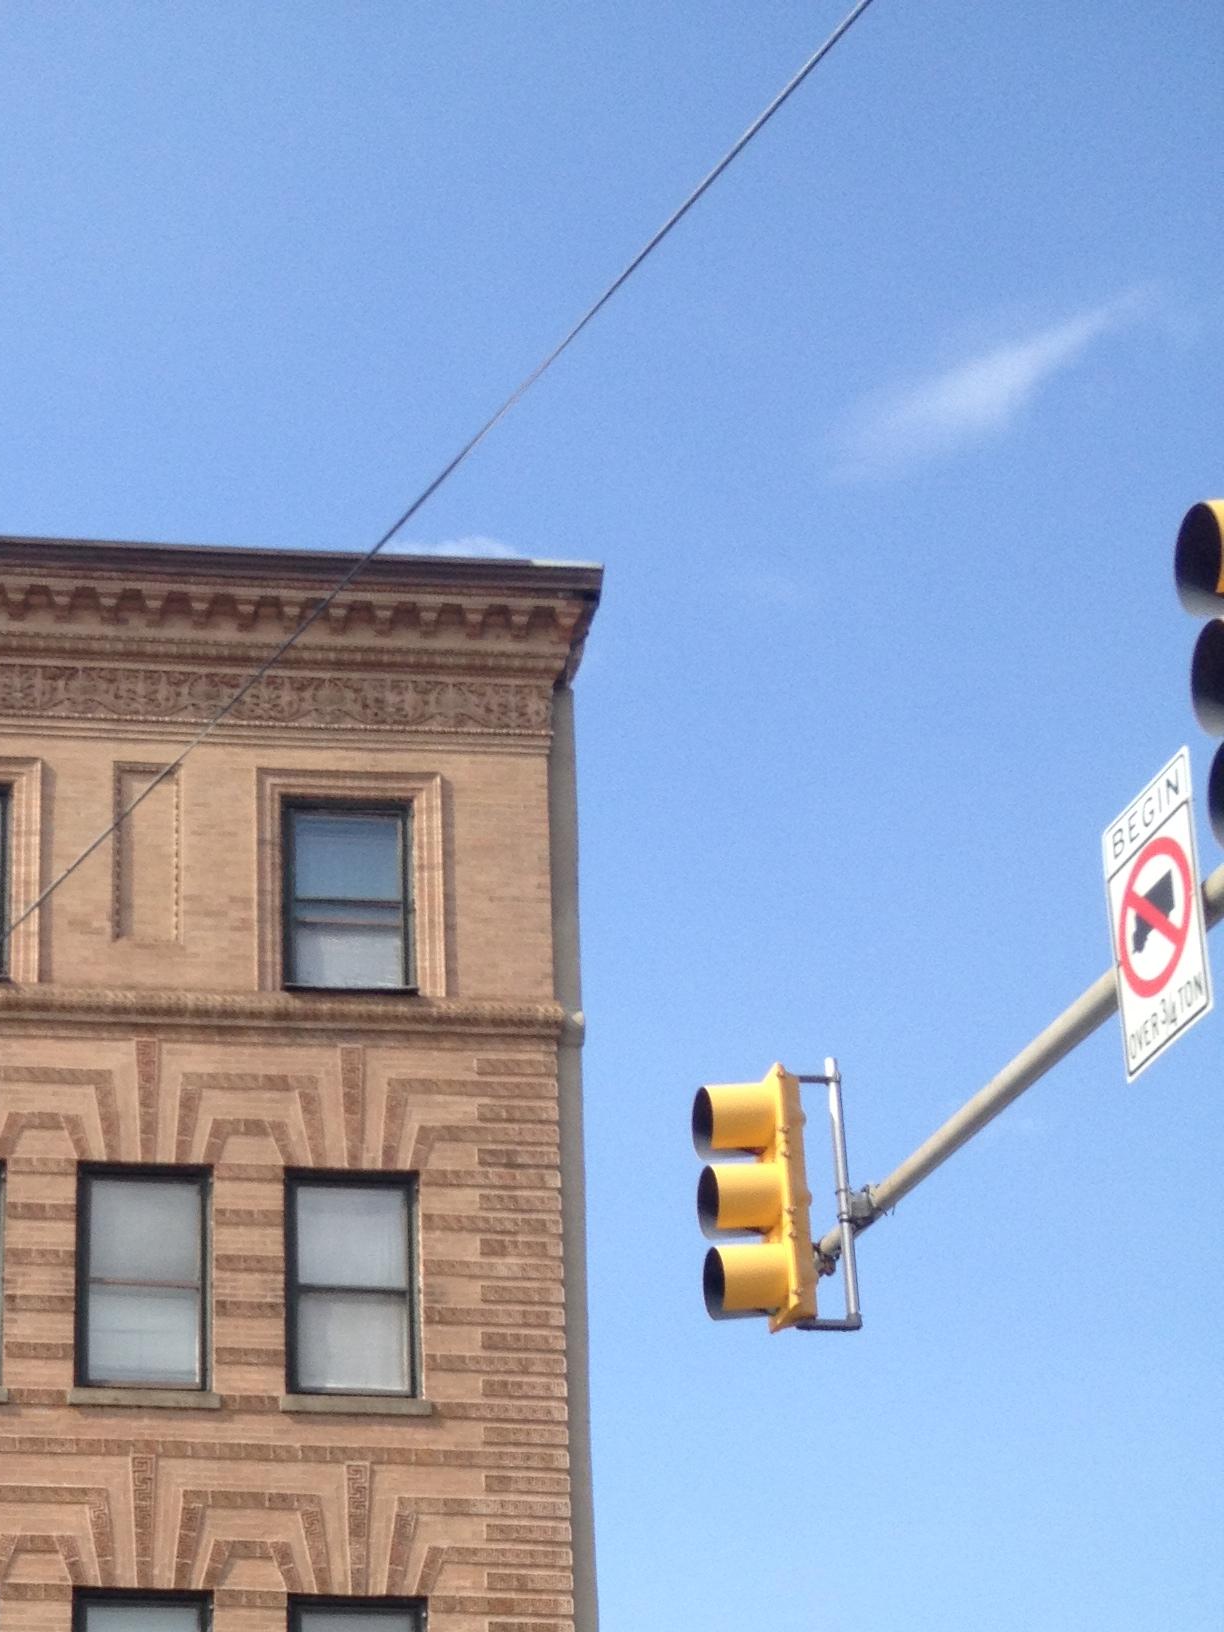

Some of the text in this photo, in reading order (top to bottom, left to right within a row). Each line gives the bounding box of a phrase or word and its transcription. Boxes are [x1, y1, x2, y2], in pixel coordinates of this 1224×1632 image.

[1112, 769, 1179, 859] BEGIN
[1129, 1012, 1159, 1060] OVER
[1178, 972, 1203, 1013] TON
